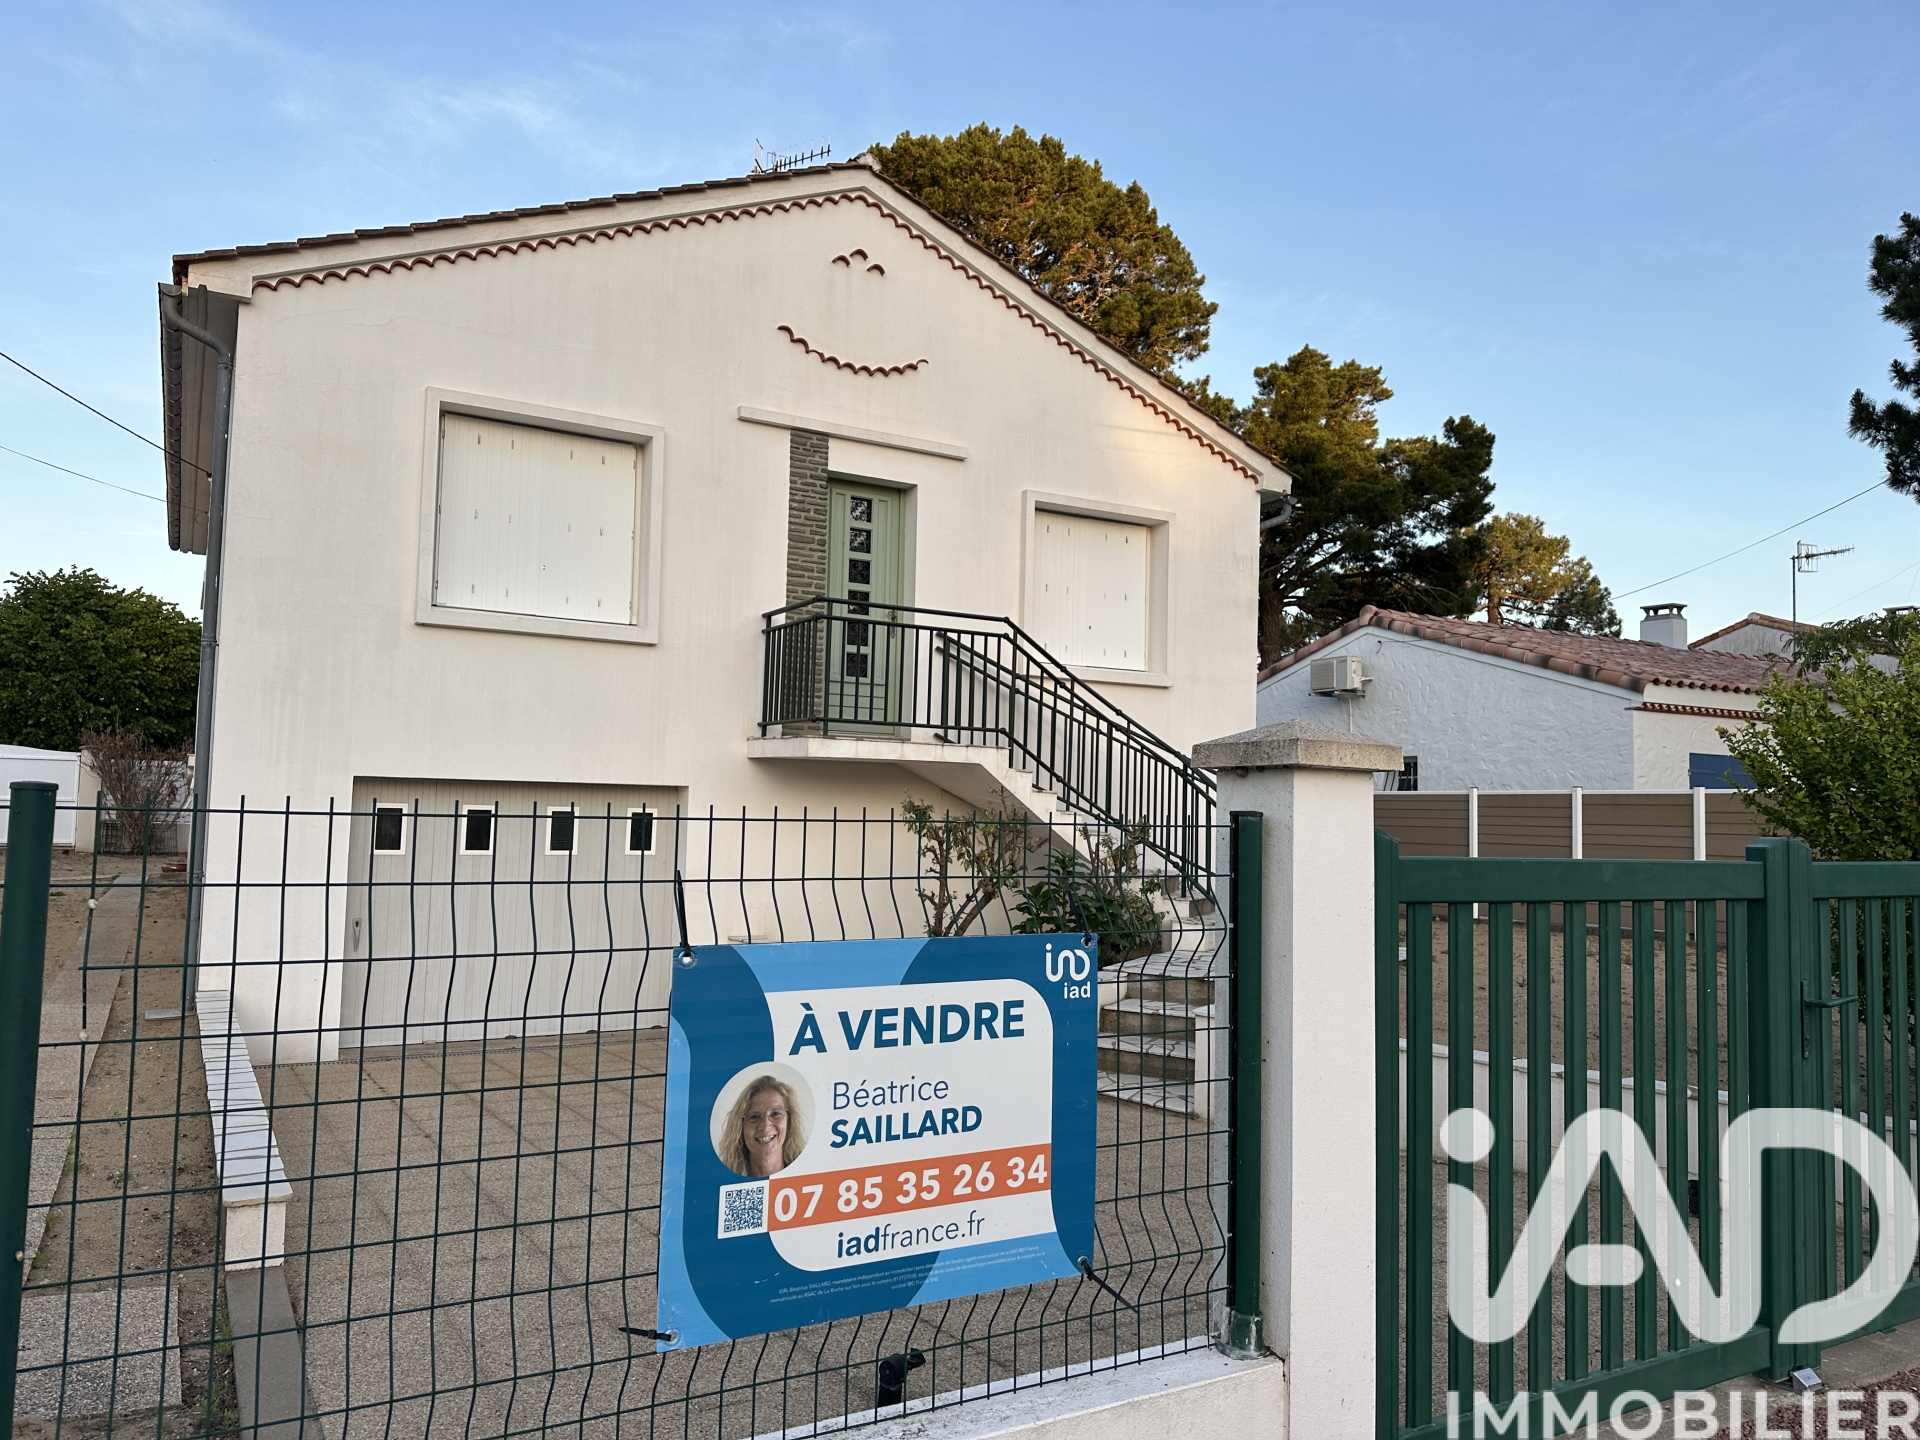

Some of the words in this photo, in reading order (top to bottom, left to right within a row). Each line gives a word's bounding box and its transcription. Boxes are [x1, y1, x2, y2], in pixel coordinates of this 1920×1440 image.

[1064, 981, 1091, 999] iad
[788, 1002, 827, 1056] À
[837, 999, 1026, 1052] VENDRE
[832, 1075, 949, 1110] Béatrice
[829, 1105, 983, 1149] SAILLARD
[773, 1183, 824, 1222] 07
[837, 1176, 884, 1213] 85
[896, 1167, 941, 1204] 35
[953, 1160, 996, 1196] 26
[1005, 1153, 1048, 1189] 34
[836, 1209, 985, 1259] iadfrance.fr
